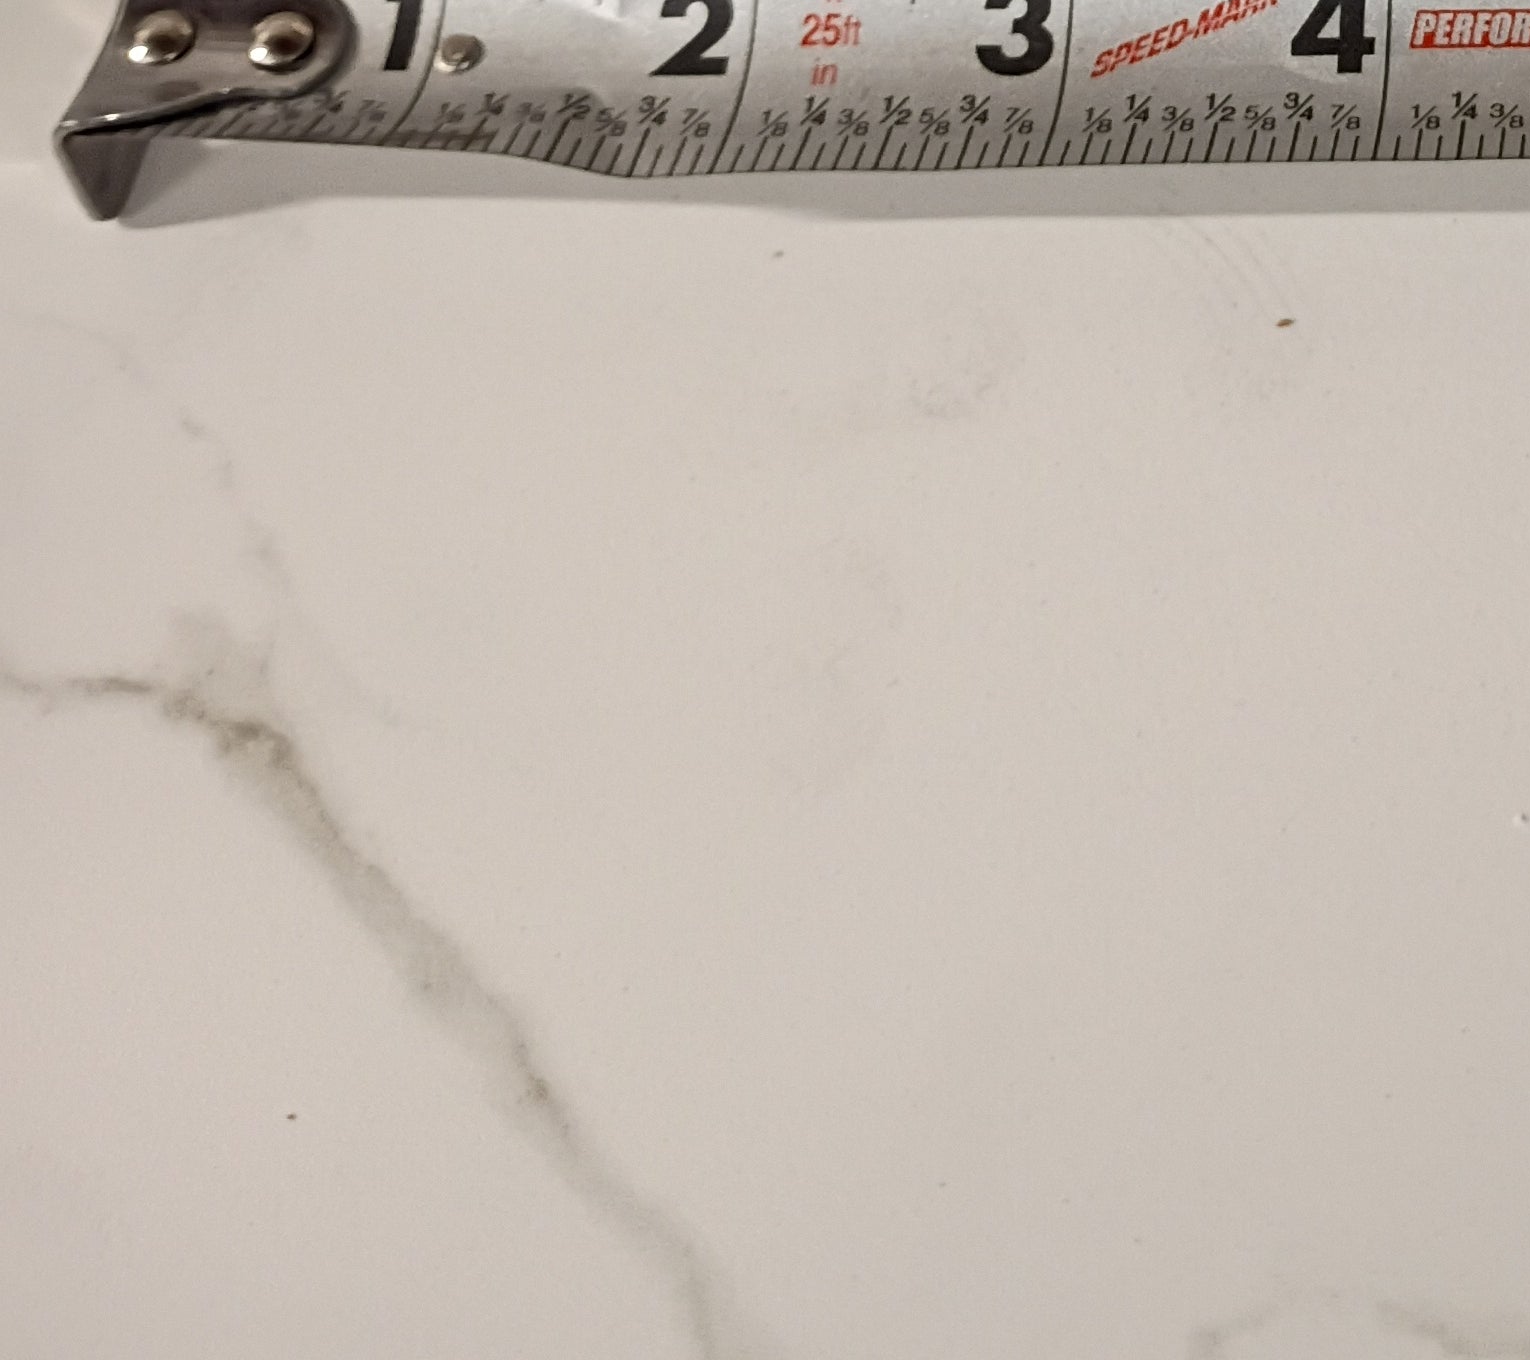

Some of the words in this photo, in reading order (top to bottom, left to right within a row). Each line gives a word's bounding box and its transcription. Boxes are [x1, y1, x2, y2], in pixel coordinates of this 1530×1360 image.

[800, 13, 861, 47] 25ft
[639, 95, 672, 125] 3/4
[680, 107, 711, 138] 7/8
[758, 109, 788, 137] 1/8
[800, 95, 831, 125] 1/4
[838, 108, 869, 136] 3/8
[880, 95, 911, 126] 1/2
[920, 107, 950, 135] 5/8
[960, 94, 991, 124] 3/4
[1003, 107, 1034, 135] 7/8
[1082, 106, 1112, 134] 1/8
[1123, 93, 1152, 122] 1/4
[1162, 105, 1194, 132] 3/8
[1204, 92, 1236, 121] 1/2
[1244, 105, 1276, 131] 5/8
[1284, 91, 1314, 120] 3/4
[1330, 103, 1361, 130] 7/8
[1411, 103, 1440, 130] 1/8
[1451, 90, 1478, 119] 1/4
[1490, 102, 1524, 129] 3/8
